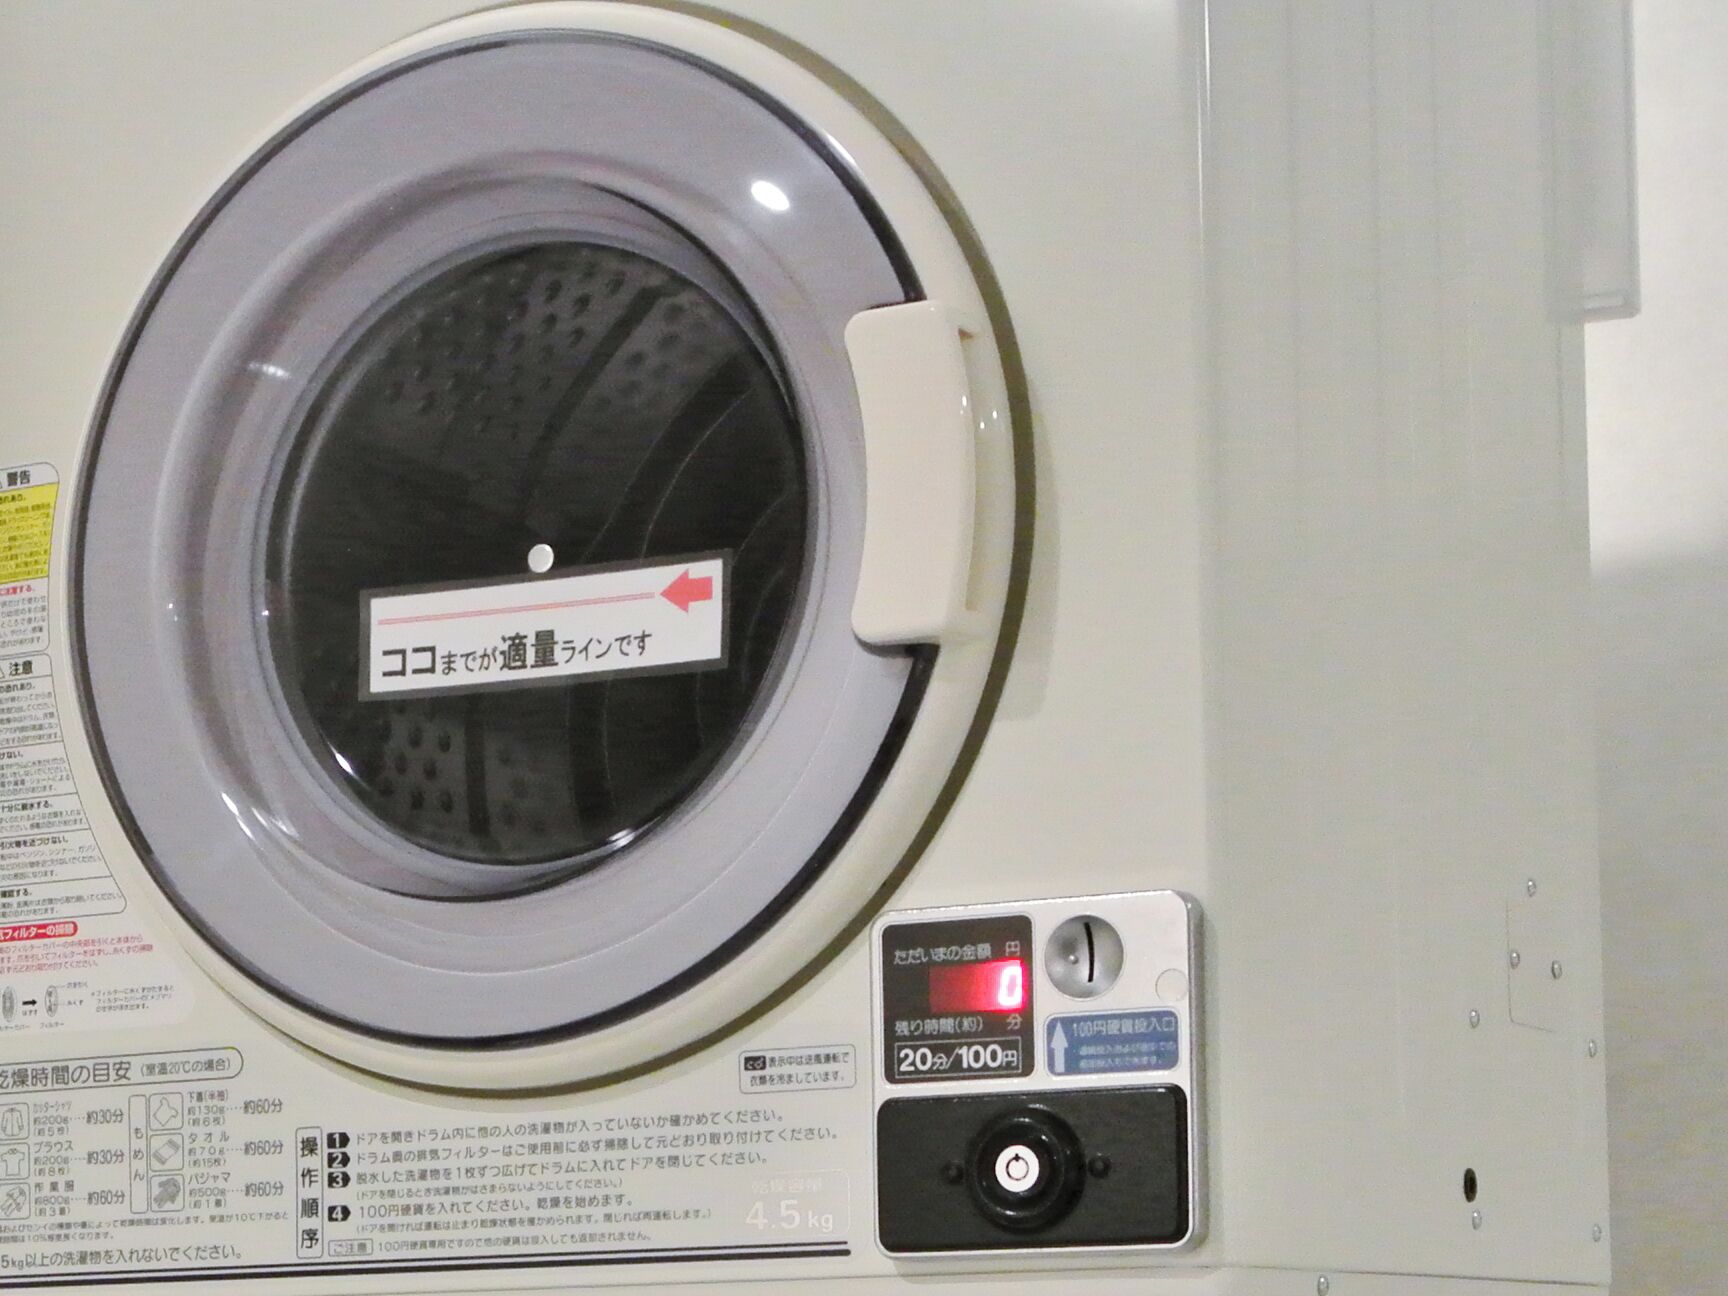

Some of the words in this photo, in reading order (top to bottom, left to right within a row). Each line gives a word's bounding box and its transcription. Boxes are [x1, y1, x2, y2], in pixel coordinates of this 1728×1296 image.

[381, 629, 652, 677] ココまでが適量ラインです
[9, 660, 32, 676] 注意
[894, 943, 992, 965] ただいまの金額
[1005, 941, 1021, 957] 円
[1007, 1013, 1022, 1030] 分
[899, 1045, 1018, 1072] 20分/100円
[300, 1136, 320, 1250] 操作順序
[746, 1199, 801, 1230] 4.5
[808, 1211, 834, 1232] kg
